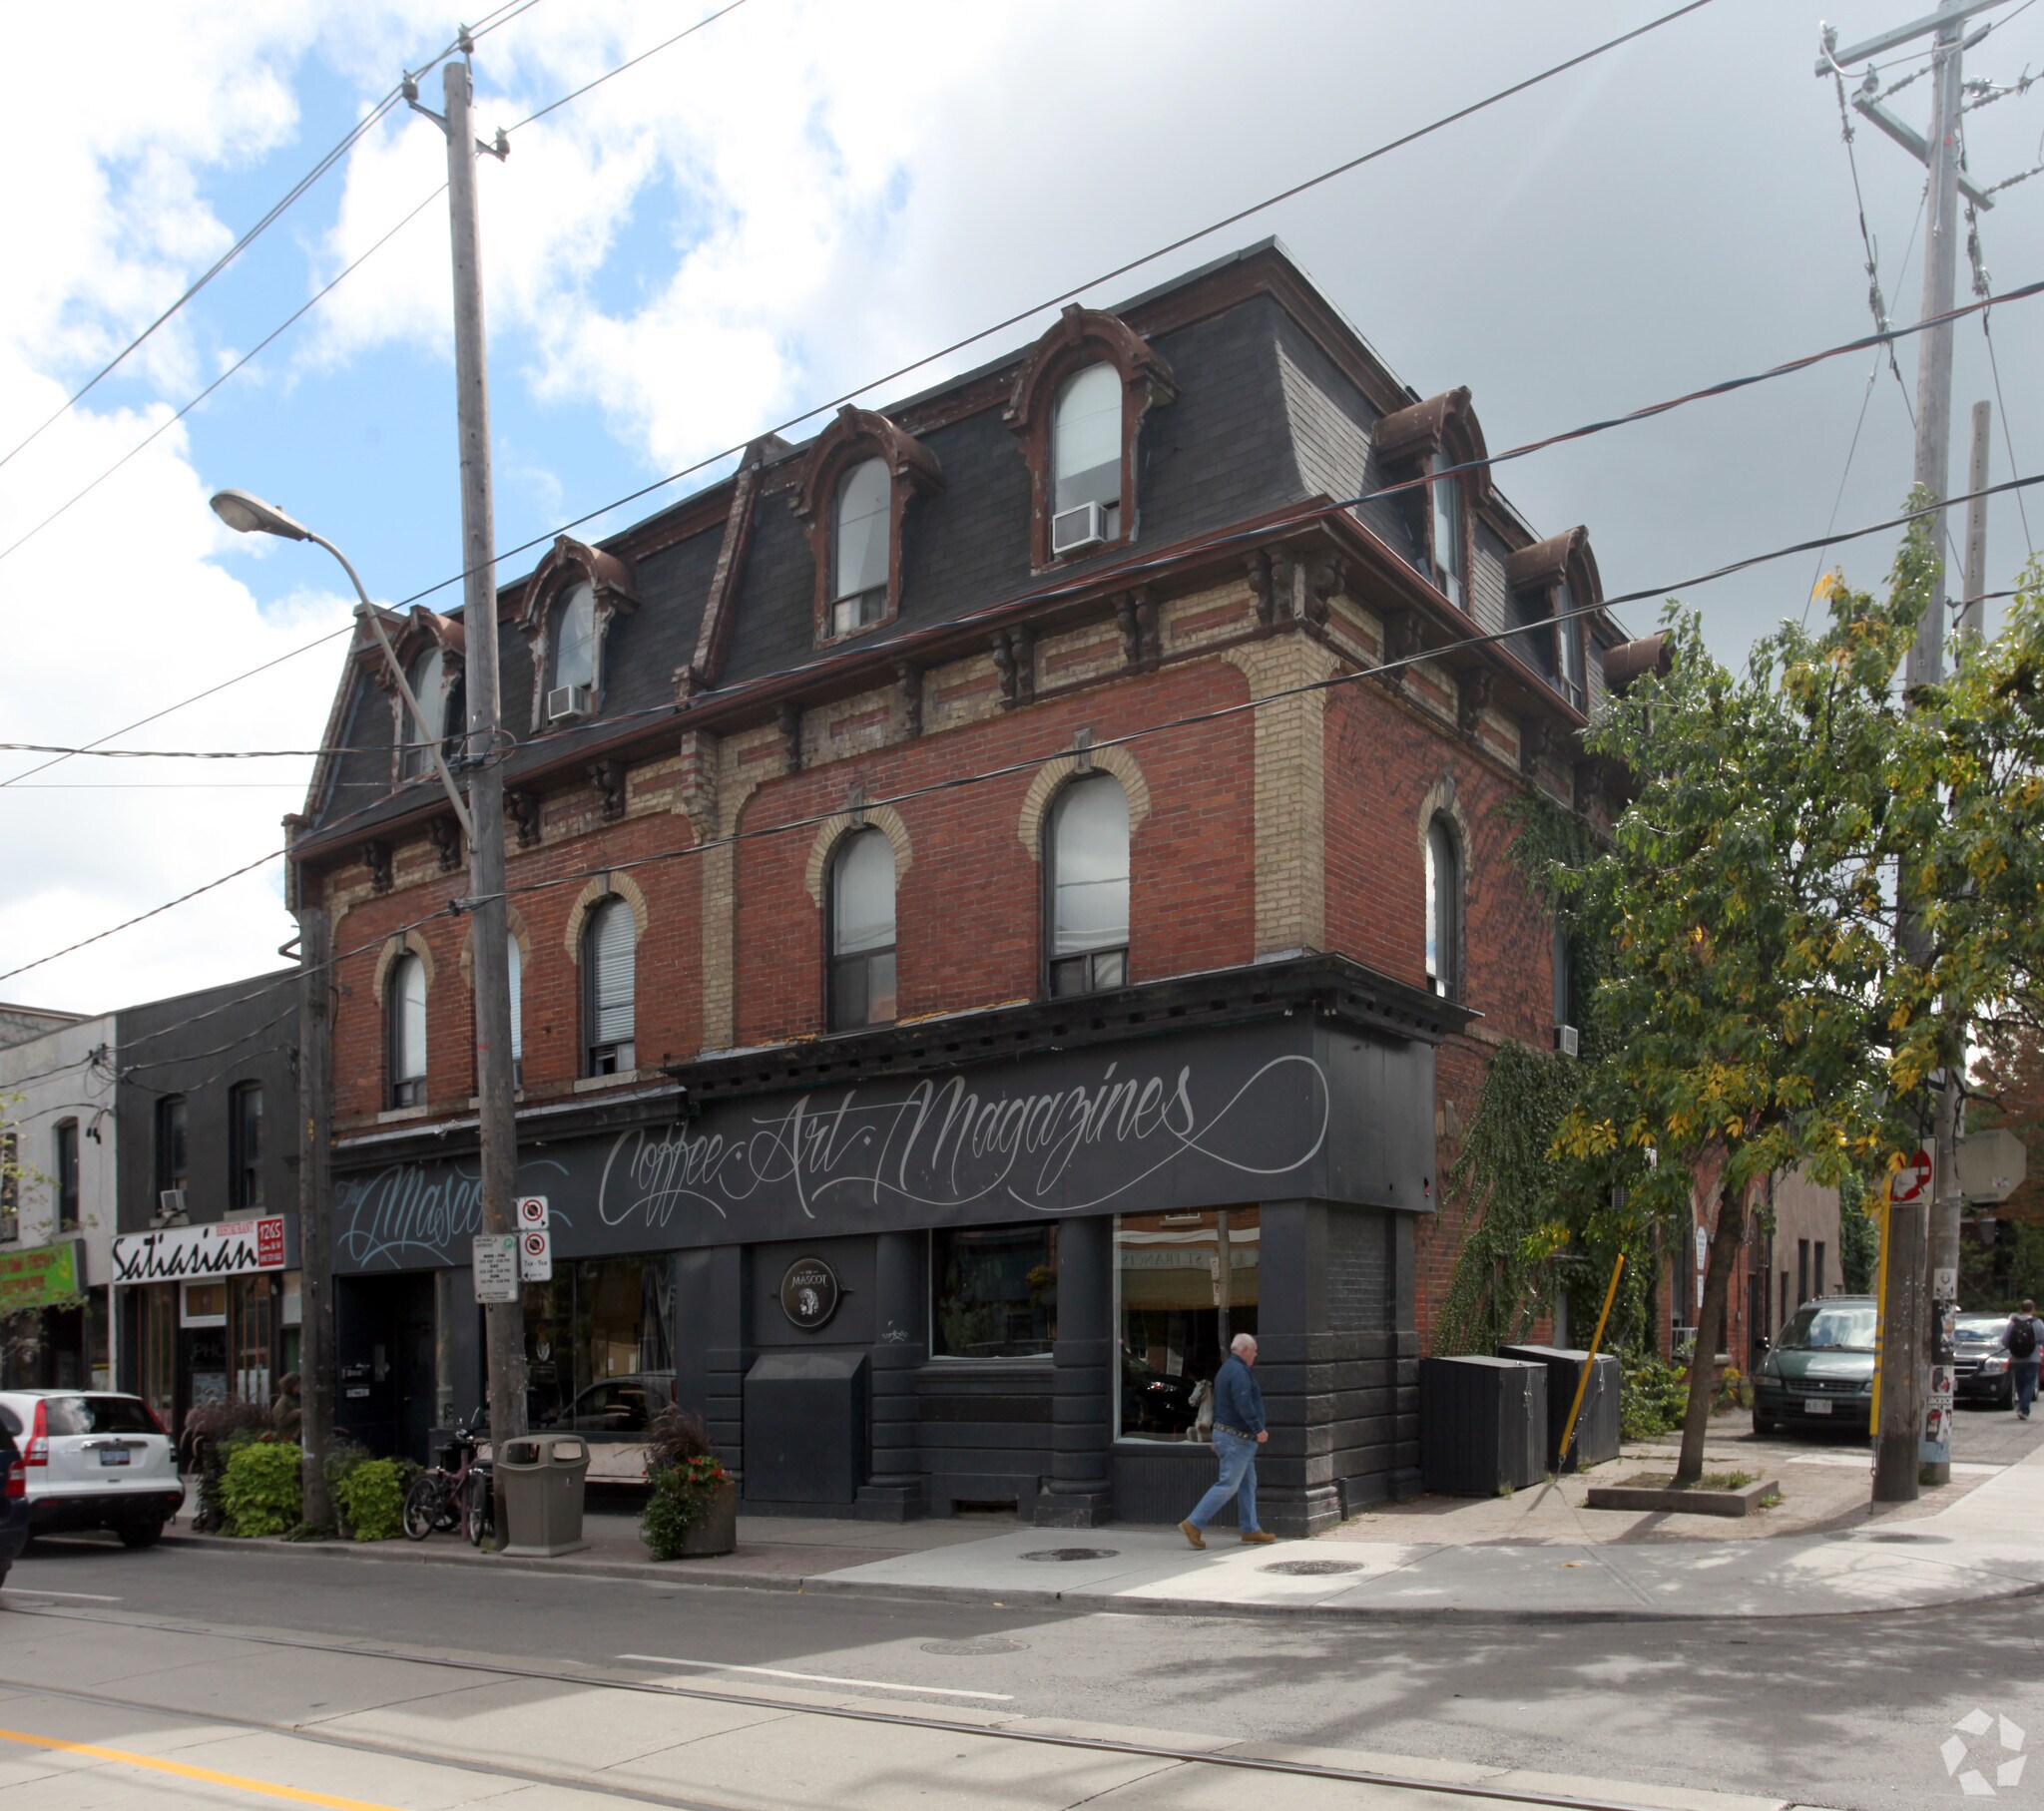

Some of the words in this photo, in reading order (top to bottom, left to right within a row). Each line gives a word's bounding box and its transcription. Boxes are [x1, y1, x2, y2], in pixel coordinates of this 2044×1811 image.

[599, 1122, 746, 1227] Coffee
[874, 1060, 1238, 1209] Magazines
[259, 1221, 281, 1241] 1265
[112, 1227, 257, 1282] Satiasian
[790, 1274, 828, 1289] MASCOT
